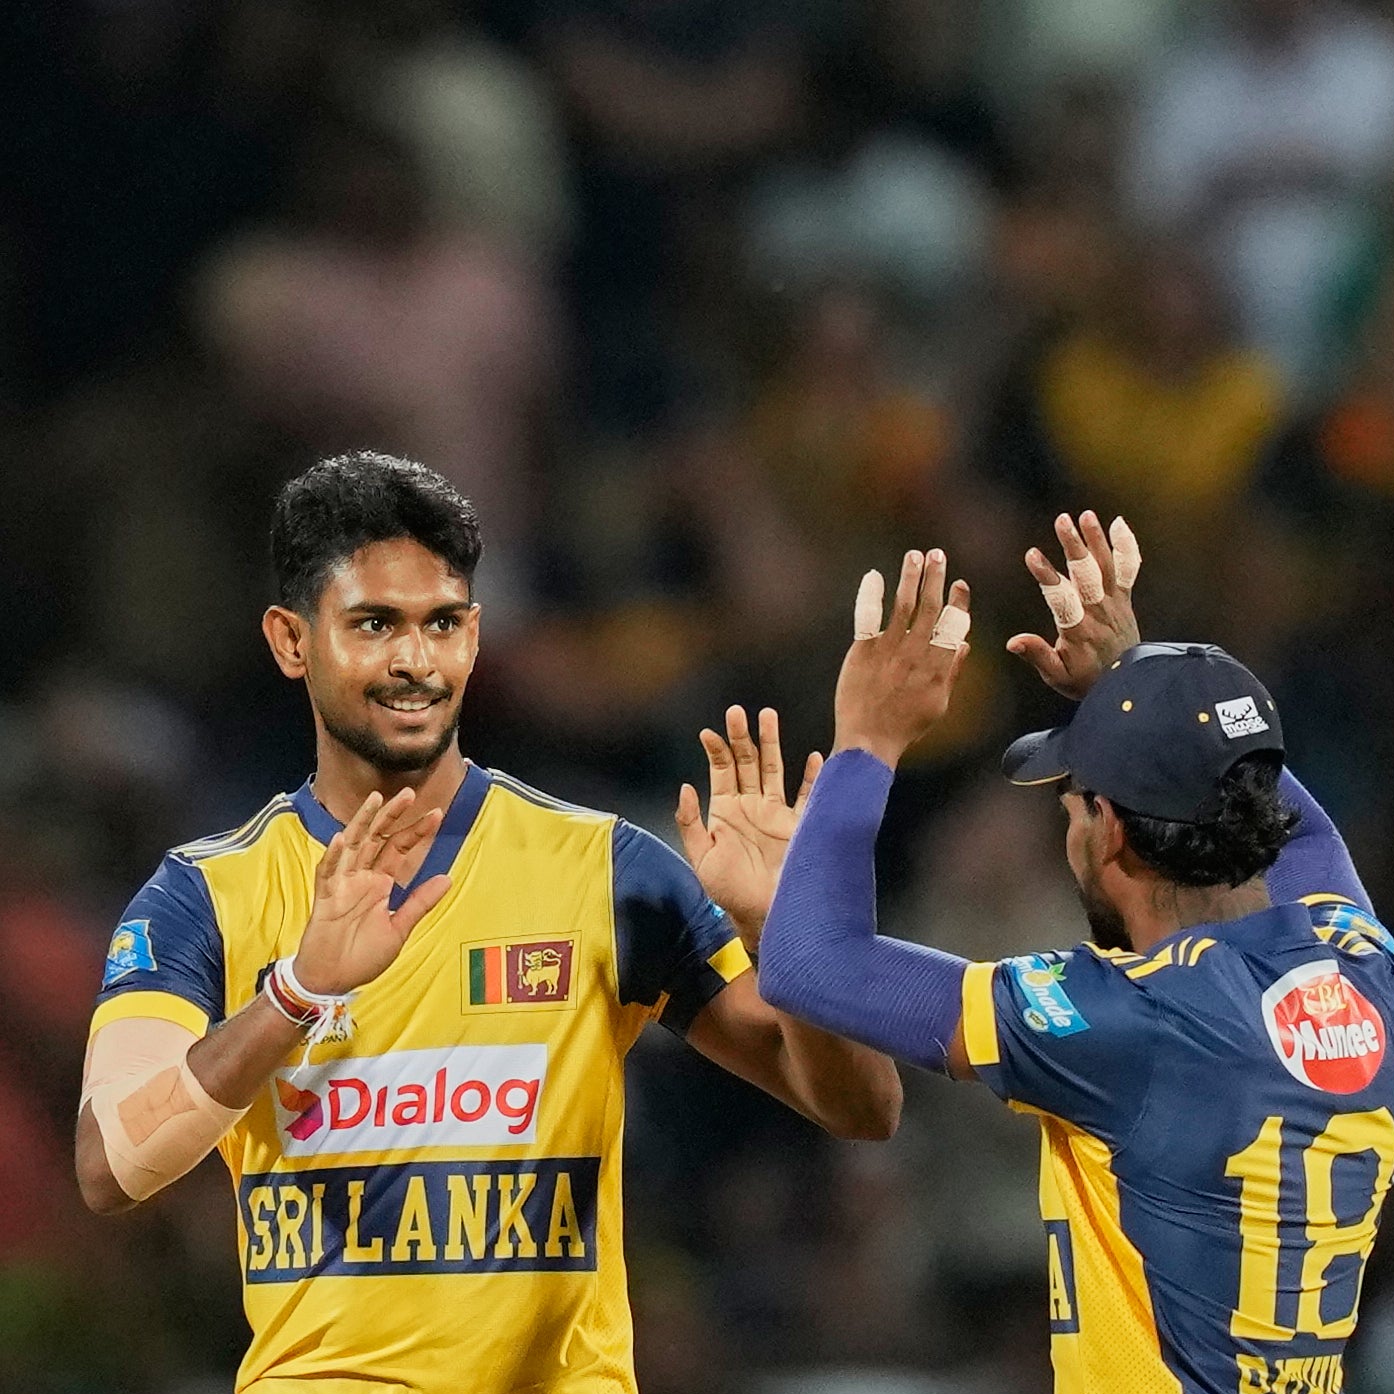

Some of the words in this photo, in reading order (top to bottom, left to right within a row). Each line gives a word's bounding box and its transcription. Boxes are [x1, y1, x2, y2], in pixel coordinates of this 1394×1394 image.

[328, 1067, 540, 1135] Dialog
[248, 1183, 326, 1271] SRI
[343, 1172, 586, 1263] LANKA
